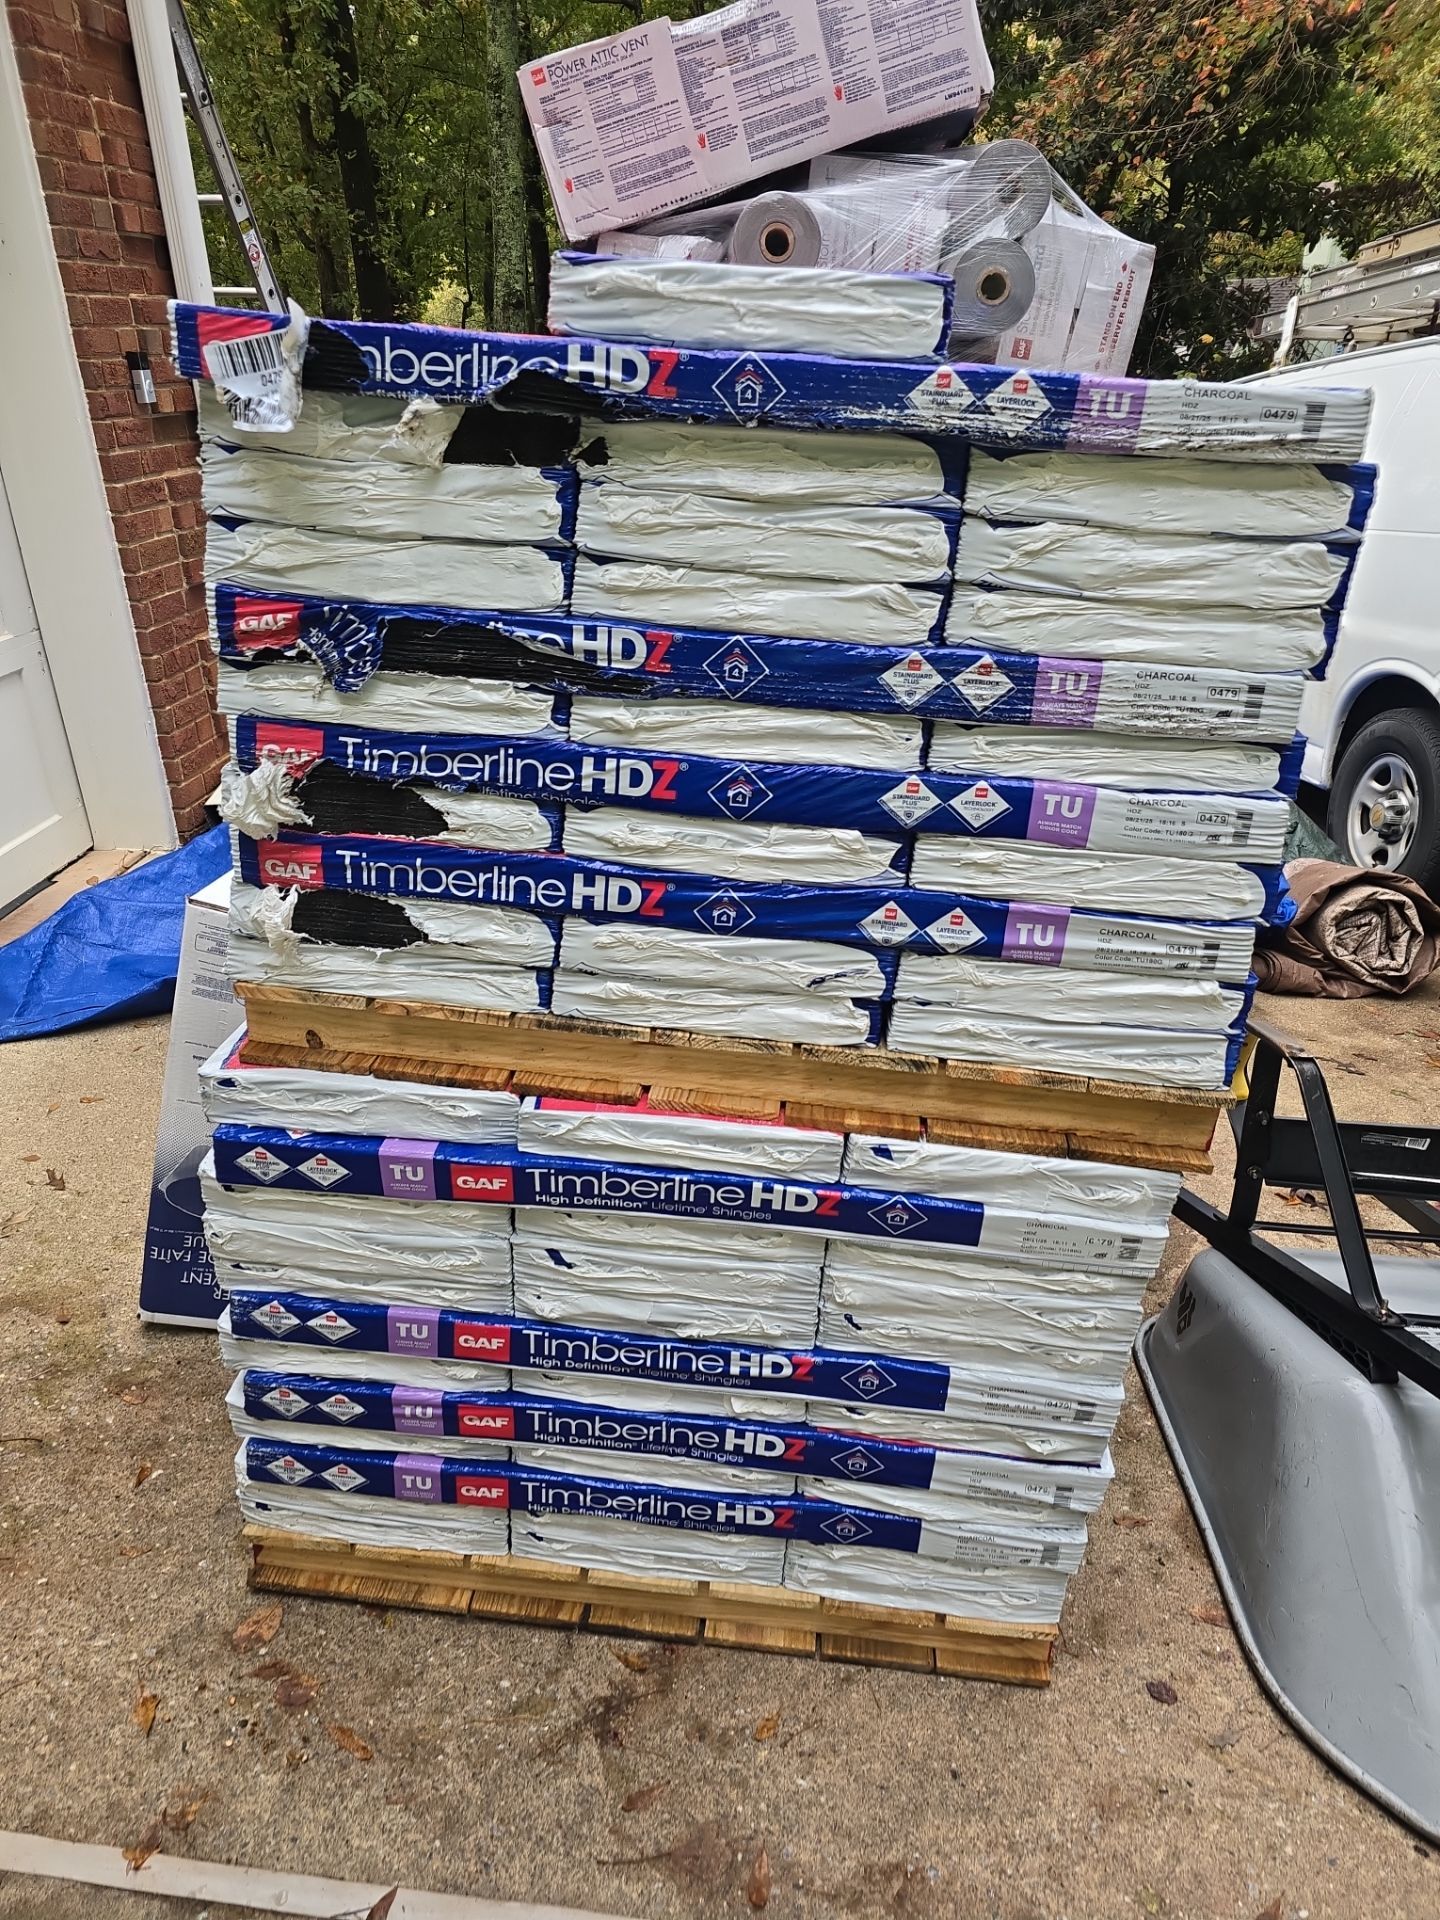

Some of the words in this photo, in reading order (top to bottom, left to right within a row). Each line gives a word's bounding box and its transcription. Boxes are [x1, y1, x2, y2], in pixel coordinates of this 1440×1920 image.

[548, 58, 586, 80] POWER
[590, 45, 619, 66] ATTIC
[620, 34, 649, 52] VENT
[1121, 268, 1136, 308] DEBOUT
[1098, 325, 1111, 353] STAND
[1108, 307, 1117, 325] ON
[1113, 281, 1124, 304] END
[1017, 338, 1026, 358] GAF
[921, 390, 964, 399] STAINGUARD
[997, 396, 1037, 407] LAYERLOCK
[1184, 388, 1252, 401] CHARCOAL
[1089, 389, 1134, 419] TU
[1264, 409, 1295, 420] 0479
[239, 613, 293, 632] GAF
[893, 672, 934, 680] STAINGUARD
[962, 678, 1001, 686] LAYERLOCK
[1136, 670, 1199, 682] CHARCOAL
[1048, 672, 1089, 696] TU
[1210, 688, 1238, 698] 0479
[338, 735, 575, 791] Timberline
[892, 794, 930, 802] STAINGUARD
[1129, 798, 1187, 808] CHARCOAL
[1043, 794, 1083, 819] TU
[1200, 814, 1227, 824] 0479
[1124, 825, 1143, 833] Color
[1144, 827, 1163, 835] Code:
[264, 859, 318, 879] GAF
[336, 849, 567, 907] Timberline
[871, 919, 908, 927] STAINGUARD
[1016, 922, 1055, 947] TU
[1099, 928, 1157, 941] CHARCOAL
[1168, 945, 1194, 955] 0479
[1094, 954, 1113, 962] Color
[389, 1164, 424, 1181] TU
[456, 1175, 508, 1190] GAF
[525, 1168, 745, 1206] Timberline
[535, 1194, 569, 1206] High
[712, 1206, 772, 1220] Shingles
[150, 1246, 191, 1264] FAÎTE
[395, 1322, 429, 1339] TU
[458, 1335, 505, 1349] GAF
[522, 1329, 724, 1374] Timberline
[529, 1356, 561, 1368] High
[694, 1373, 751, 1386] Shingles
[401, 1405, 433, 1419] TU
[463, 1415, 509, 1428] GAF
[534, 1433, 565, 1444] High
[691, 1448, 744, 1463] Shingles
[402, 1475, 432, 1490] TU
[460, 1486, 504, 1499] GAF
[520, 1481, 712, 1520] Timberline
[683, 1521, 736, 1533] Shingles
